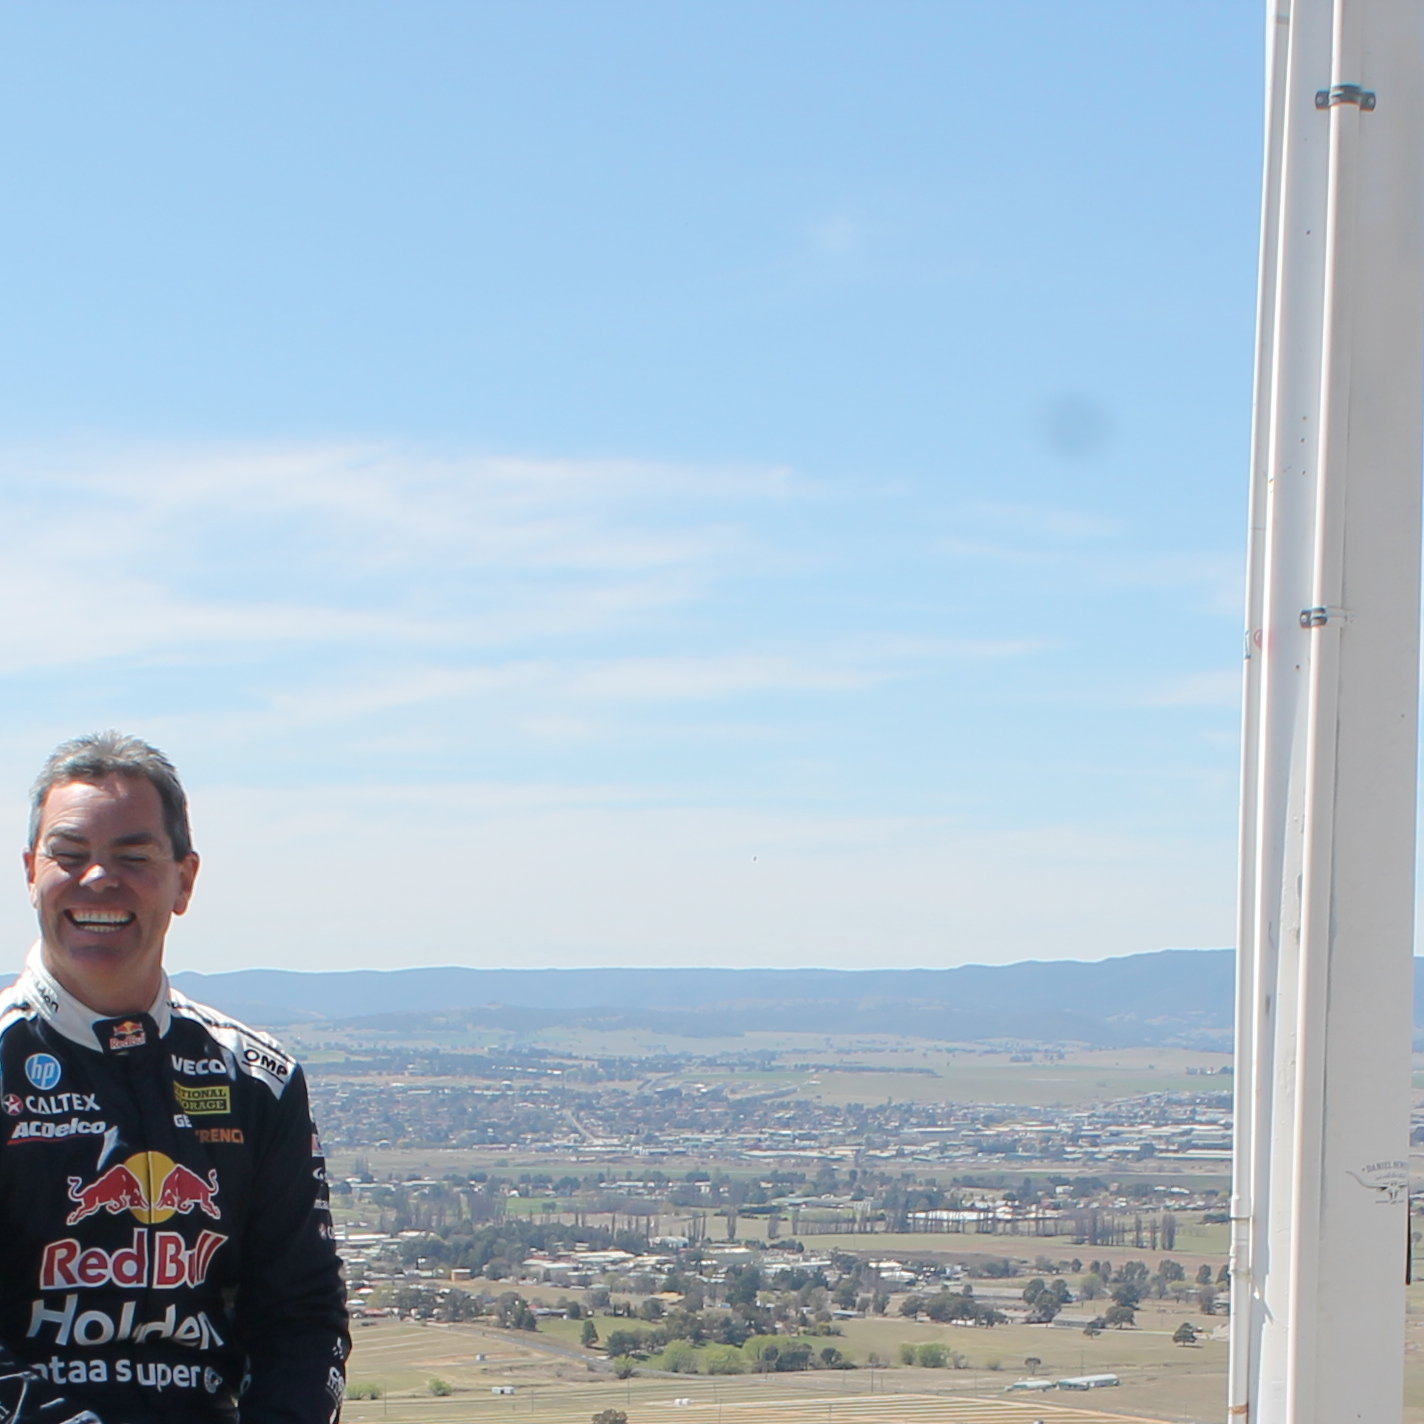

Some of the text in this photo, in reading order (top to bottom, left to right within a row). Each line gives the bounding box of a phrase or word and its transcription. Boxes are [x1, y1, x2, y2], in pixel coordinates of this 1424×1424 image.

[32, 1059, 56, 1088] hp
[243, 1048, 288, 1077] OMP
[26, 1093, 101, 1114] CALTEX
[39, 1228, 229, 1290] Red Bull
[26, 1293, 225, 1350] Holden
